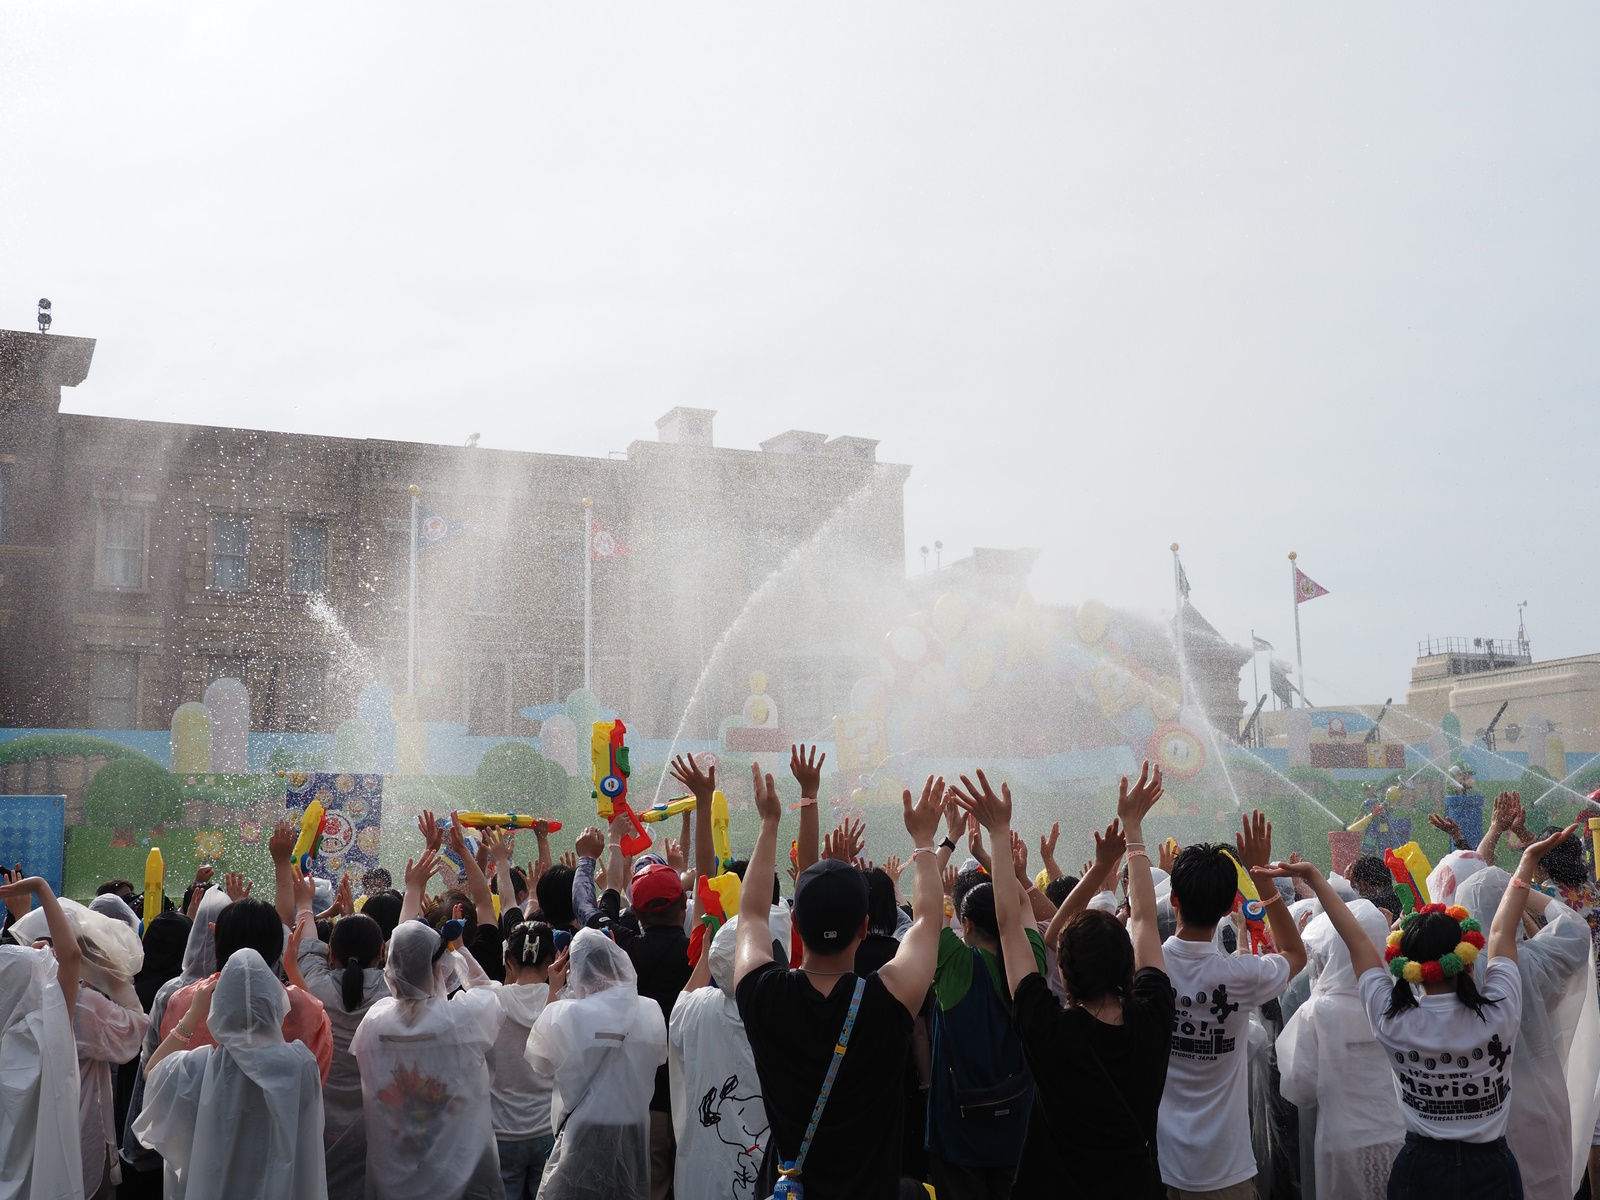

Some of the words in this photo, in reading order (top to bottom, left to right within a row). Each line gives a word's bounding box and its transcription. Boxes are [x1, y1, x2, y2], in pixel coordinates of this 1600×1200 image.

[1399, 1072, 1490, 1098] Mario!
[1418, 1113, 1453, 1121] UNIVERSAL
[1455, 1113, 1483, 1121] STUDIOS
